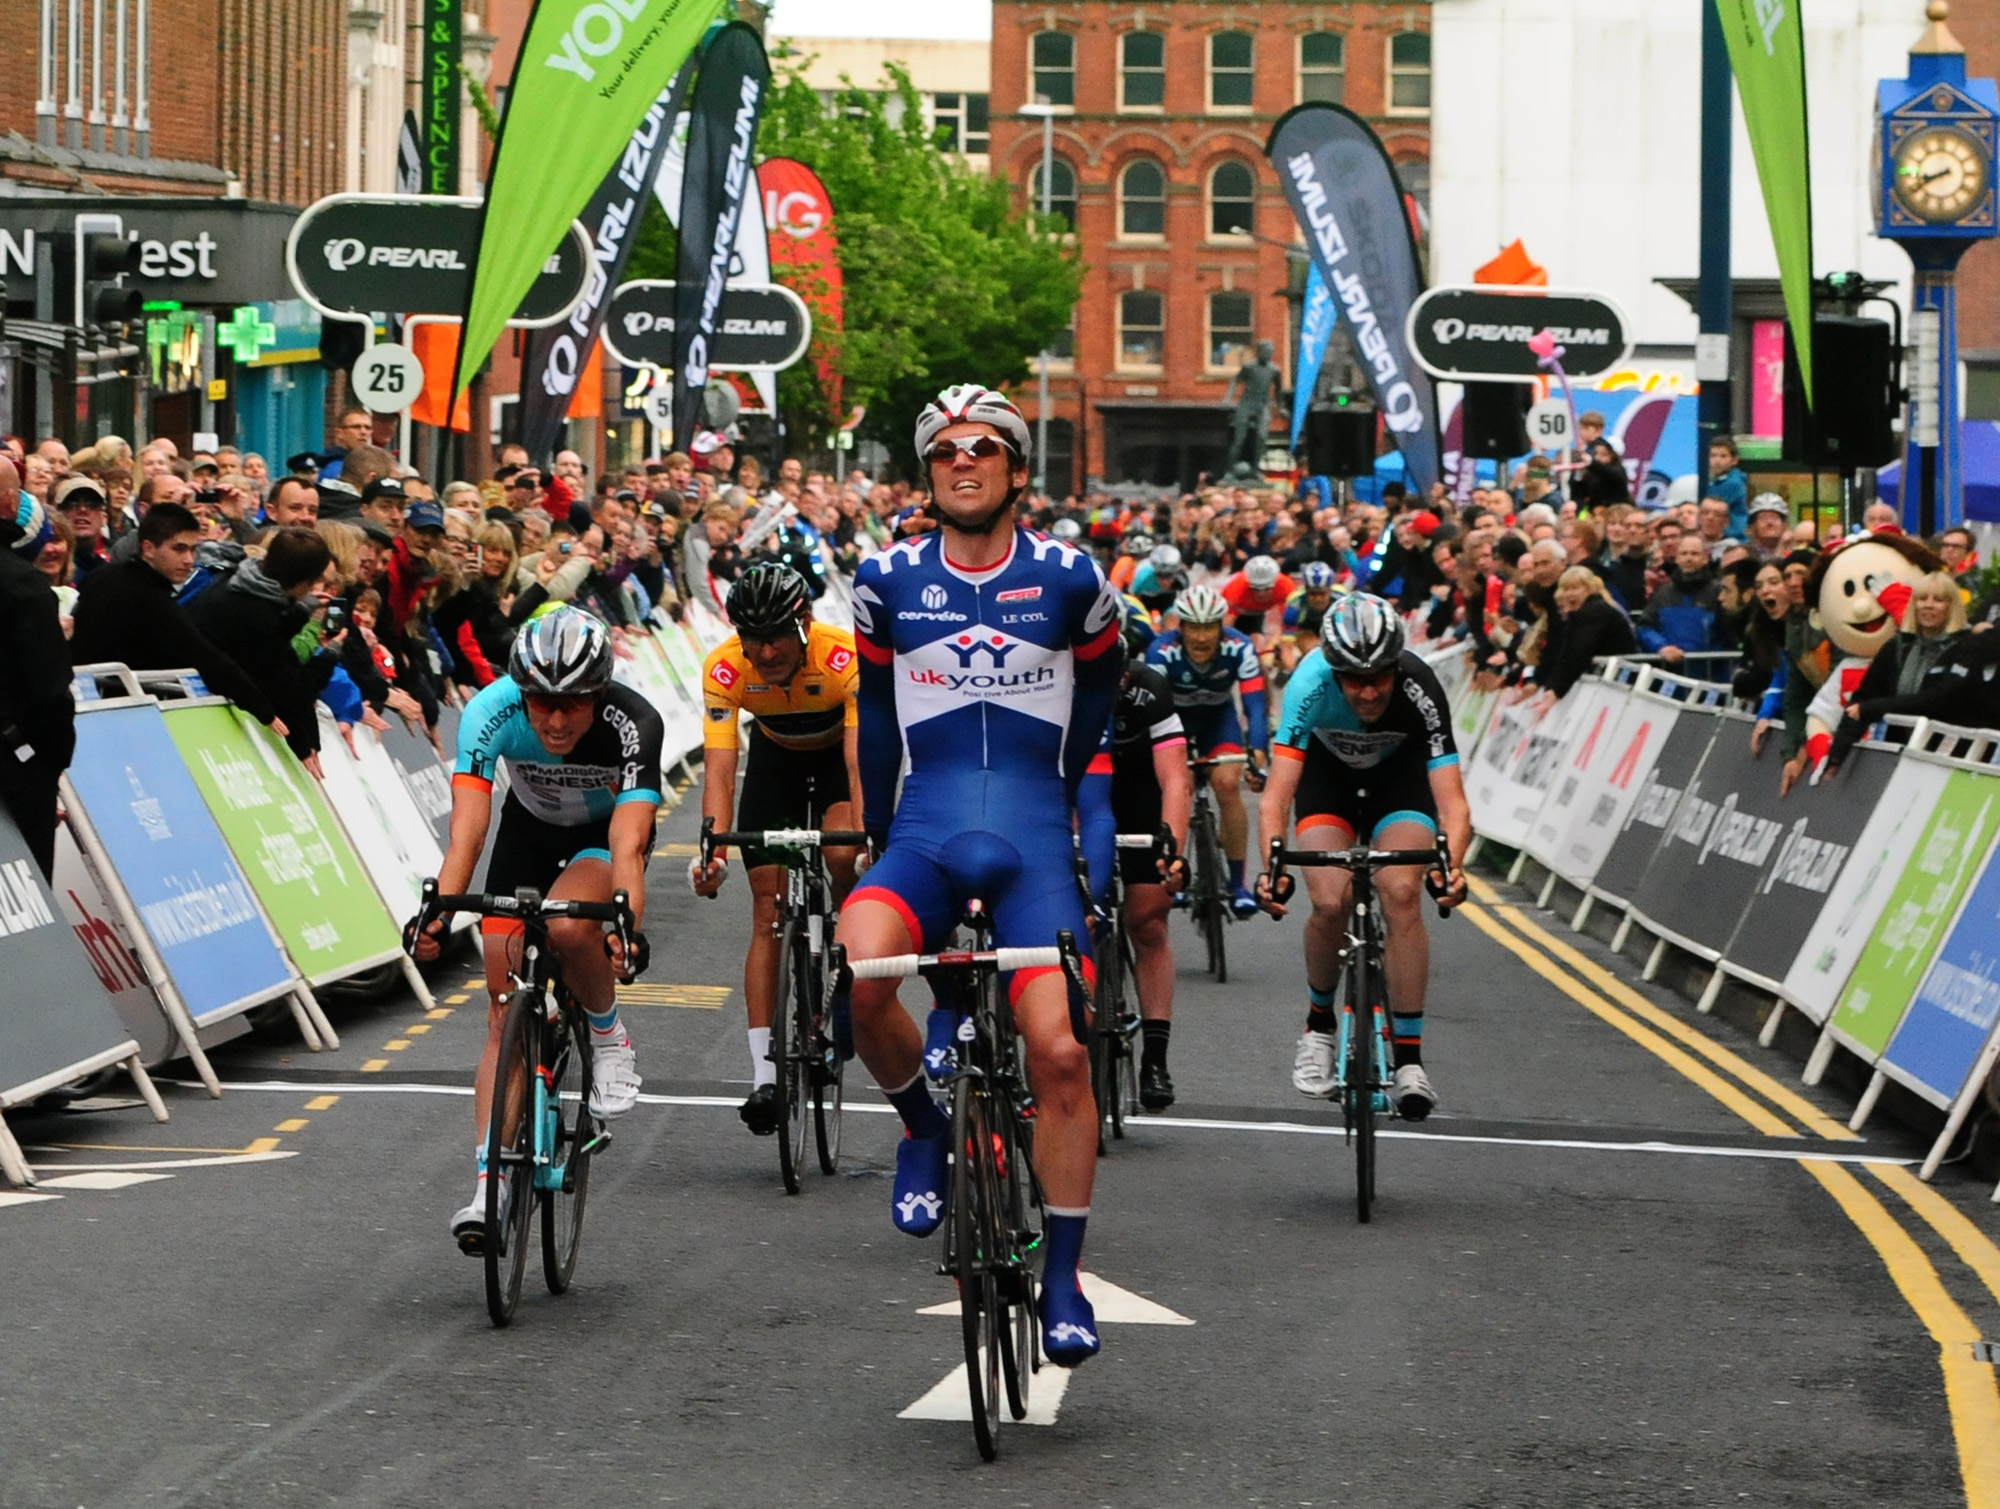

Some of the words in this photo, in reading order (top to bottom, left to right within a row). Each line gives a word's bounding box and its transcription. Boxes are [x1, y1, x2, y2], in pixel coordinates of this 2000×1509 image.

[431, 20, 451, 43] &
[599, 73, 625, 100] Your
[624, 24, 662, 73] delivery,
[429, 52, 451, 194] SPENCE
[766, 189, 823, 240] IG
[367, 246, 467, 270] PEARL
[569, 197, 635, 340] PEARL
[702, 204, 737, 335] PEARL
[1465, 324, 1534, 343] PEARL
[1547, 327, 1611, 345] ZUMI
[368, 363, 405, 393] 25
[1539, 414, 1566, 435] 50
[1001, 614, 1018, 624] LE
[1021, 611, 1048, 623] COL
[711, 663, 733, 685] IG
[829, 651, 851, 671] IG
[1004, 687, 1031, 697] About
[477, 699, 524, 747] MADISON
[602, 704, 640, 758] GENESIS
